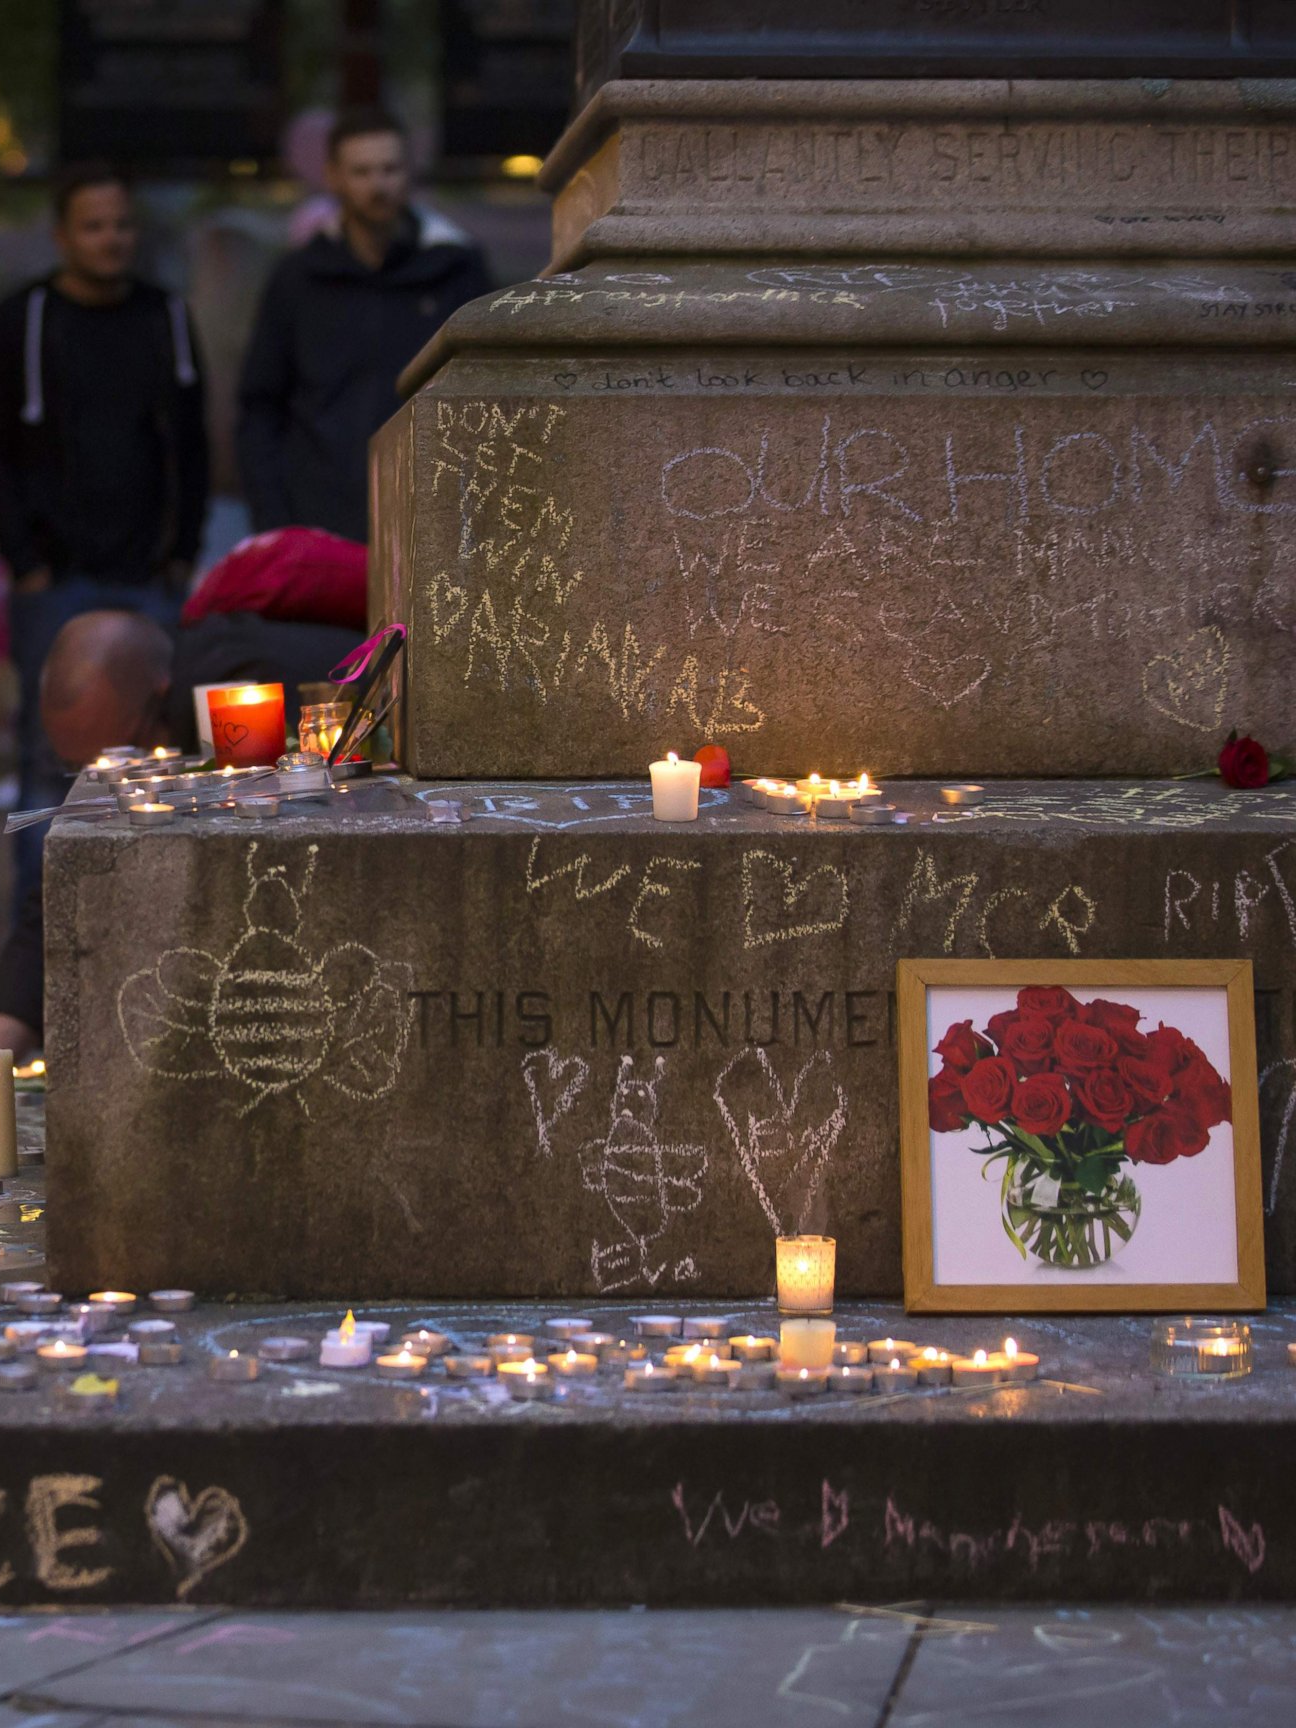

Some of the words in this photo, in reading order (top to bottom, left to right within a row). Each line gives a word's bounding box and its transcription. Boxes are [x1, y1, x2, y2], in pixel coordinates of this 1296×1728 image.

[932, 131, 1136, 183] SERVING
[1157, 131, 1296, 183] THEIR
[1200, 302, 1248, 318] STAY
[591, 366, 676, 391] don't
[695, 367, 767, 389] look
[782, 366, 870, 388] back
[891, 370, 931, 388] in
[943, 366, 1059, 393] anger
[661, 414, 923, 521] OUR
[672, 516, 782, 581] WE
[685, 583, 789, 641] WE
[1160, 868, 1270, 944] RIP
[406, 989, 554, 1049] THIS
[671, 1481, 782, 1547] We
